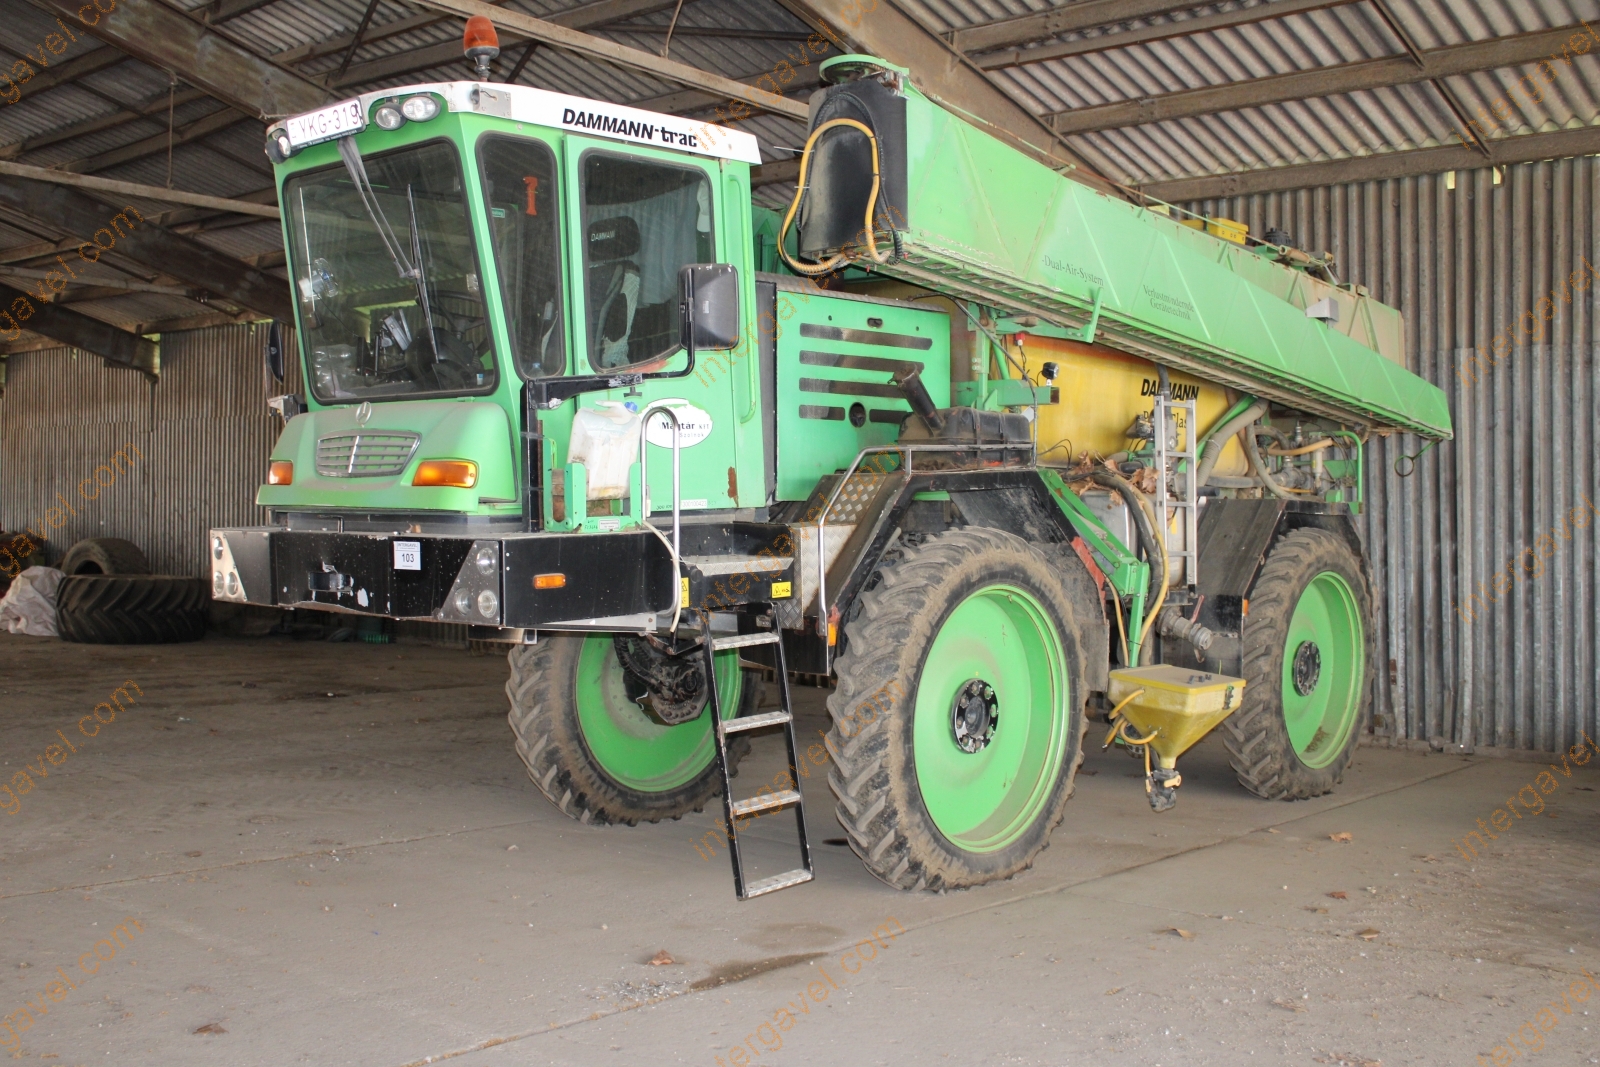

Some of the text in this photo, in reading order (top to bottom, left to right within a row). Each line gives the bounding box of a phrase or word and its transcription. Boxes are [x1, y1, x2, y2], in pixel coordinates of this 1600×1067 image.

[298, 103, 360, 139] YKG-319
[562, 108, 697, 148] DAMMANN-trac
[1141, 378, 1200, 401] DAMANN
[402, 553, 415, 563] 103
